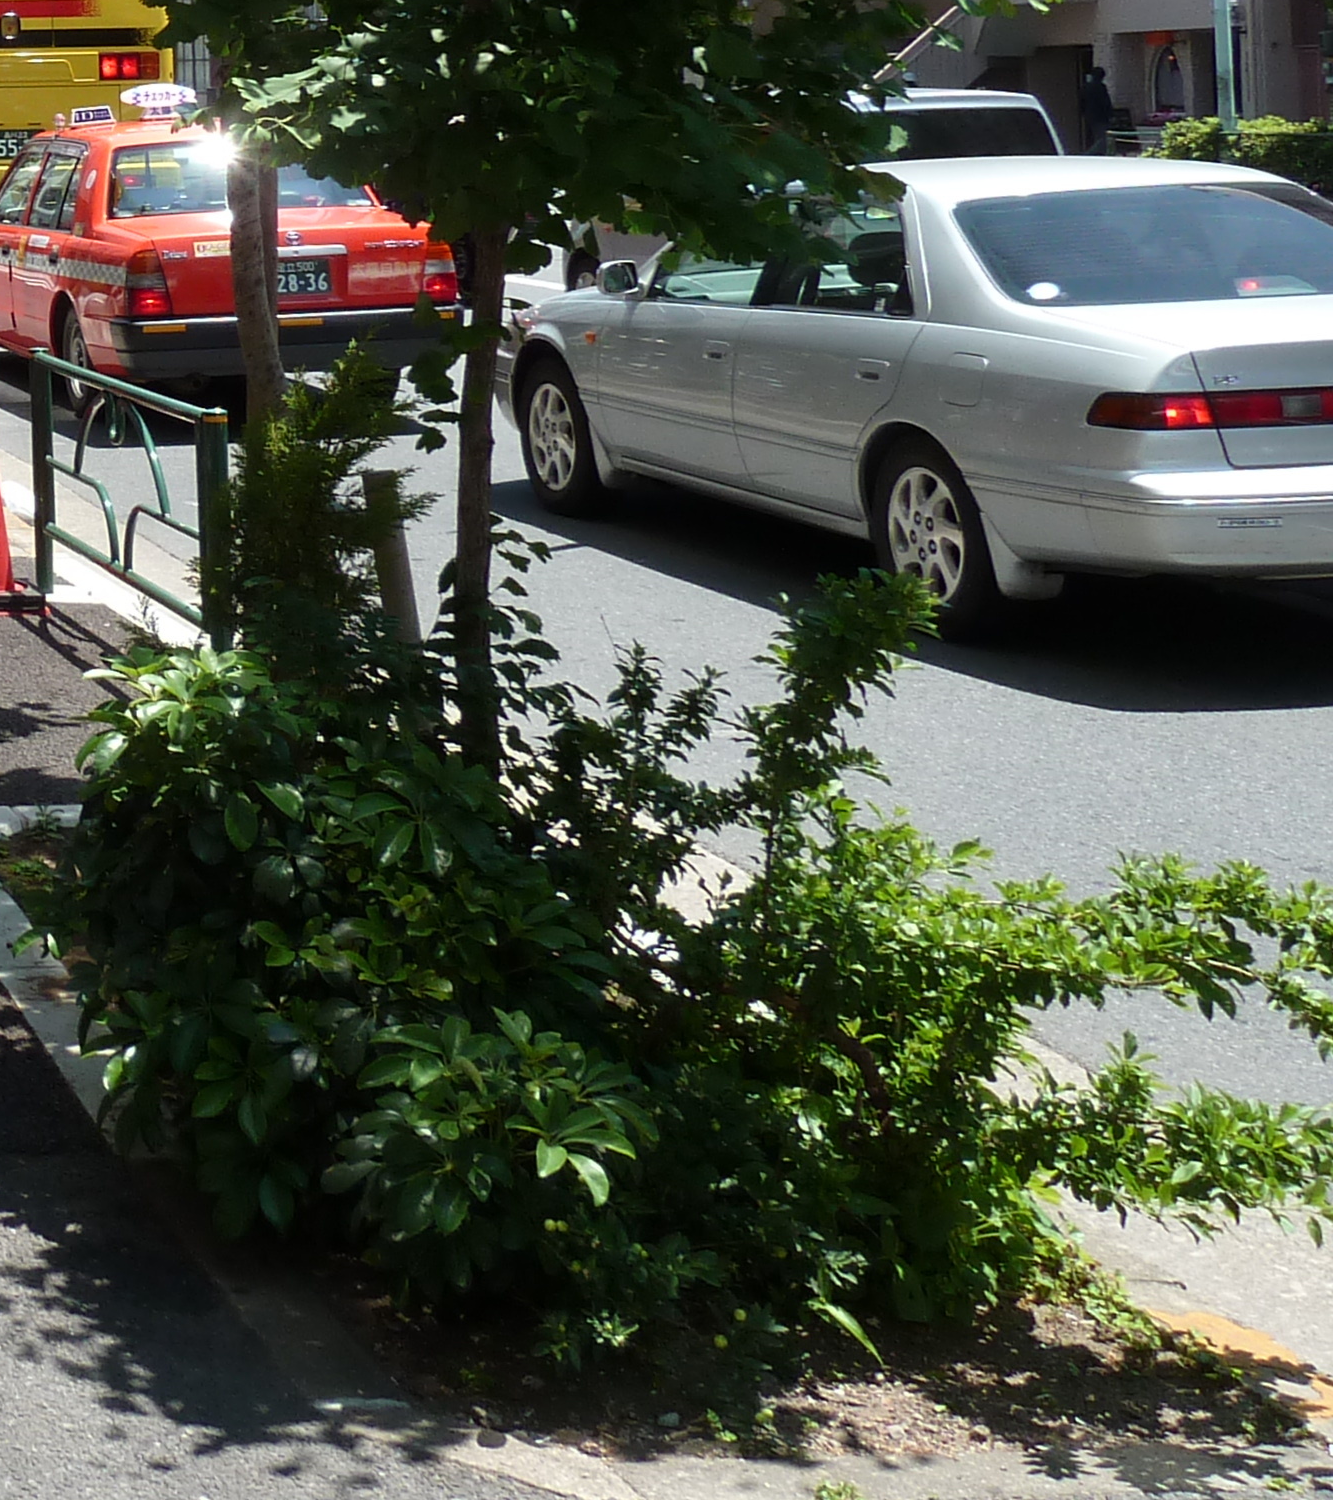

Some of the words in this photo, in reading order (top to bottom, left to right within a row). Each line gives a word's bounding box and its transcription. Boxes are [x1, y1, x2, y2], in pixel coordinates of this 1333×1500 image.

[143, 91, 176, 102] チェッカー
